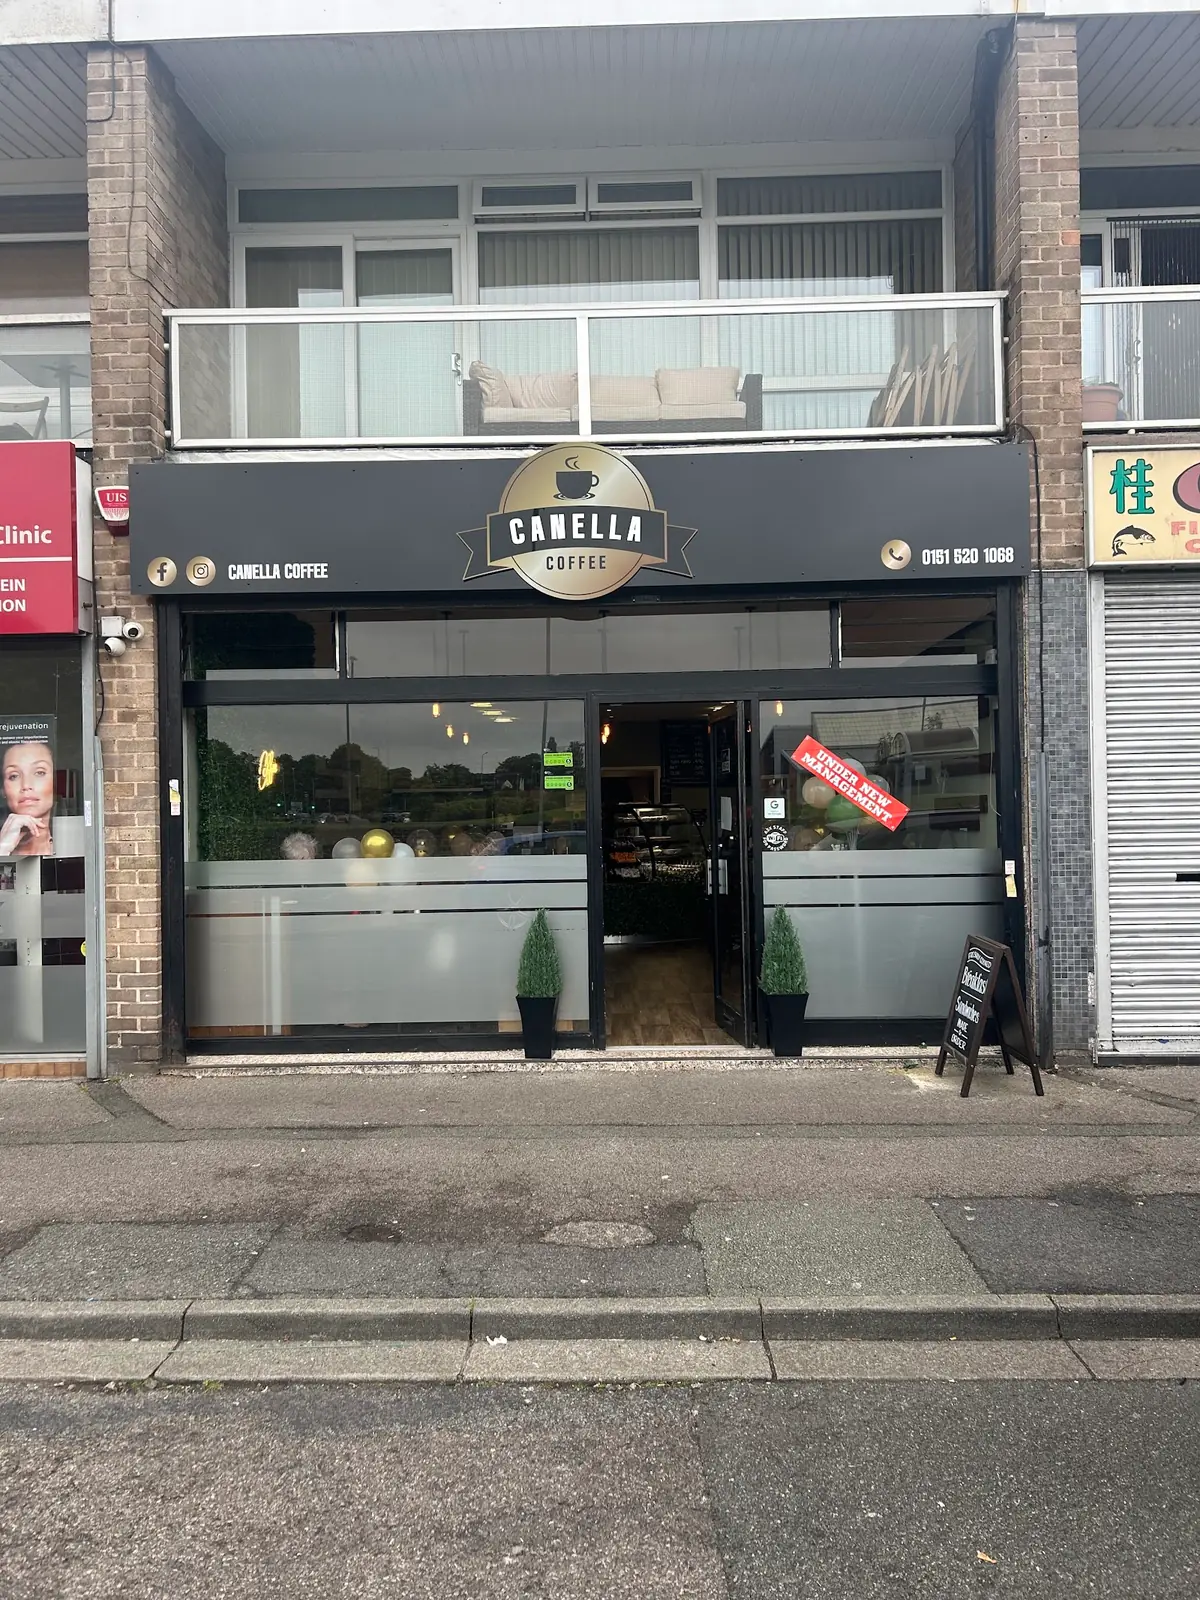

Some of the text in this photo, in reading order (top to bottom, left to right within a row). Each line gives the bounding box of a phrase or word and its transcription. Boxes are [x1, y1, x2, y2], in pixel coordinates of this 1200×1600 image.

[1109, 458, 1155, 514] 桂
[106, 492, 127, 502] UIS
[509, 513, 642, 545] CANELLA
[546, 555, 607, 570] COFFEE
[922, 547, 1014, 565] 0151 520 1068
[228, 563, 328, 580] CANELLA COFFEE
[0, 579, 26, 592] EIN
[801, 752, 892, 822] MANAGEMENT
[816, 749, 892, 807] UNDER NEW
